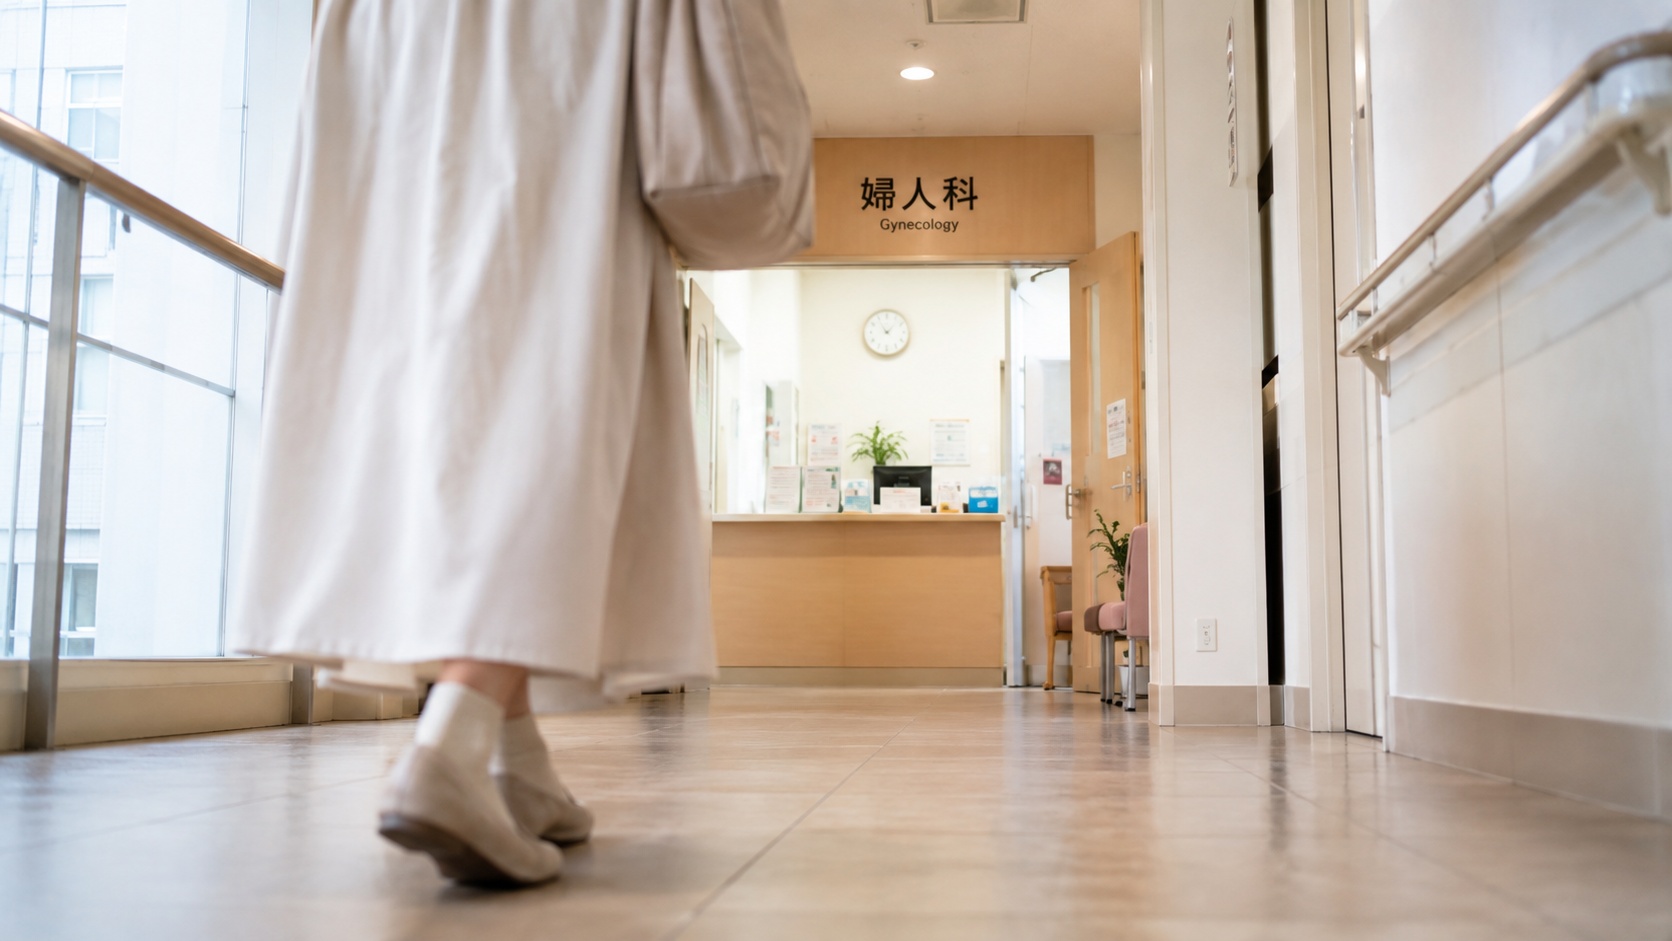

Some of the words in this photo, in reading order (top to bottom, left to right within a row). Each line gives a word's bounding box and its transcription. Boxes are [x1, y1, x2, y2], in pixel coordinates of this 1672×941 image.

[860, 176, 979, 212] 婦人科
[879, 218, 960, 233] Gynecology
